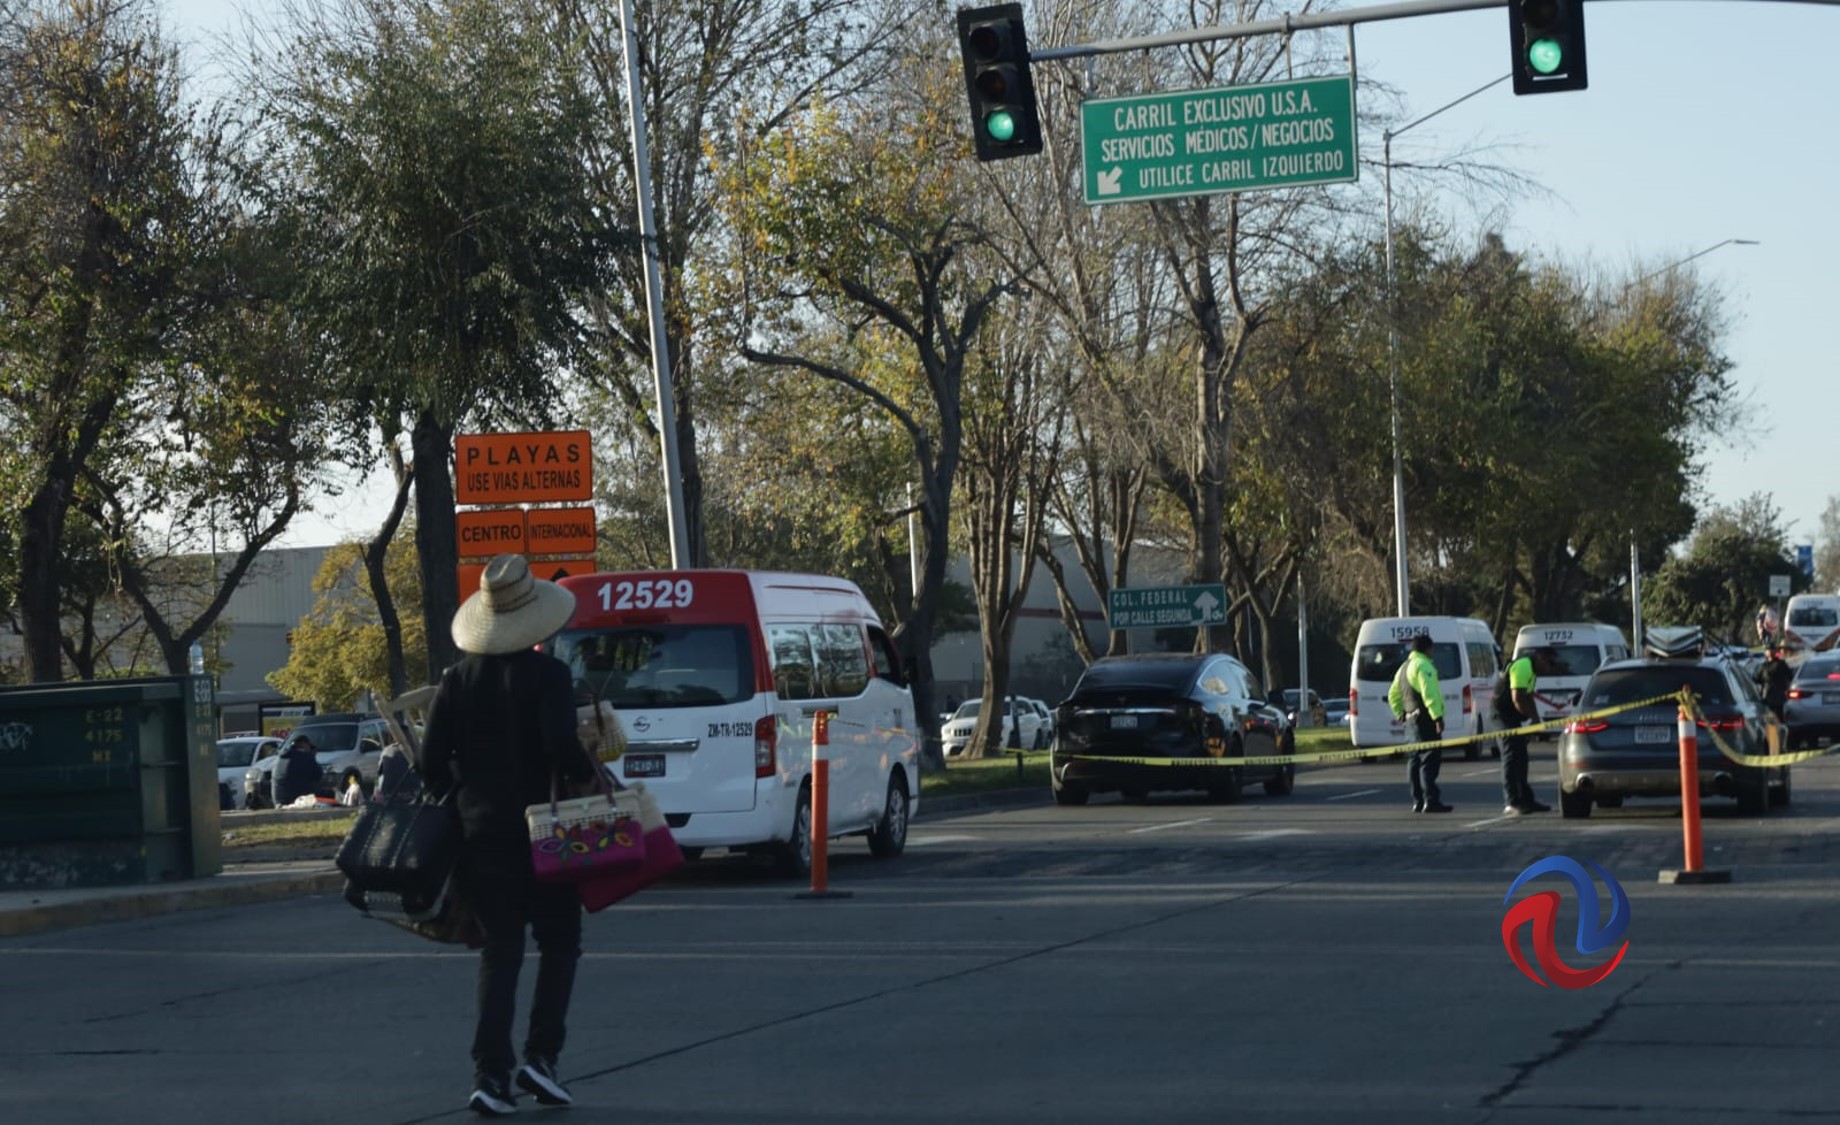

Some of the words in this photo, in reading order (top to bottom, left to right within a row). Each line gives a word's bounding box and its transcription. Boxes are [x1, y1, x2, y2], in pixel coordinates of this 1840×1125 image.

[1114, 103, 1176, 131] CARRIL
[1184, 93, 1265, 124] EXCLUSIVO
[1271, 89, 1318, 116] U.S.A.
[1101, 133, 1175, 163] SERVICIOS
[1139, 164, 1194, 189] UTILICE
[1202, 158, 1255, 183] CARRIL
[1263, 149, 1343, 178] IZQUIERDO
[467, 443, 580, 466] PLAYAS
[468, 472, 490, 492] USE
[493, 471, 519, 491] VIAS
[522, 469, 580, 490] ALTERNAS
[462, 524, 522, 543] CENTRO
[529, 522, 592, 540] INTERNACIONAL
[598, 579, 694, 612] 12529
[1113, 593, 1138, 607] COL.
[1141, 590, 1187, 606] FEDERAL
[1113, 611, 1129, 626] POR
[1131, 609, 1155, 624] CALLE
